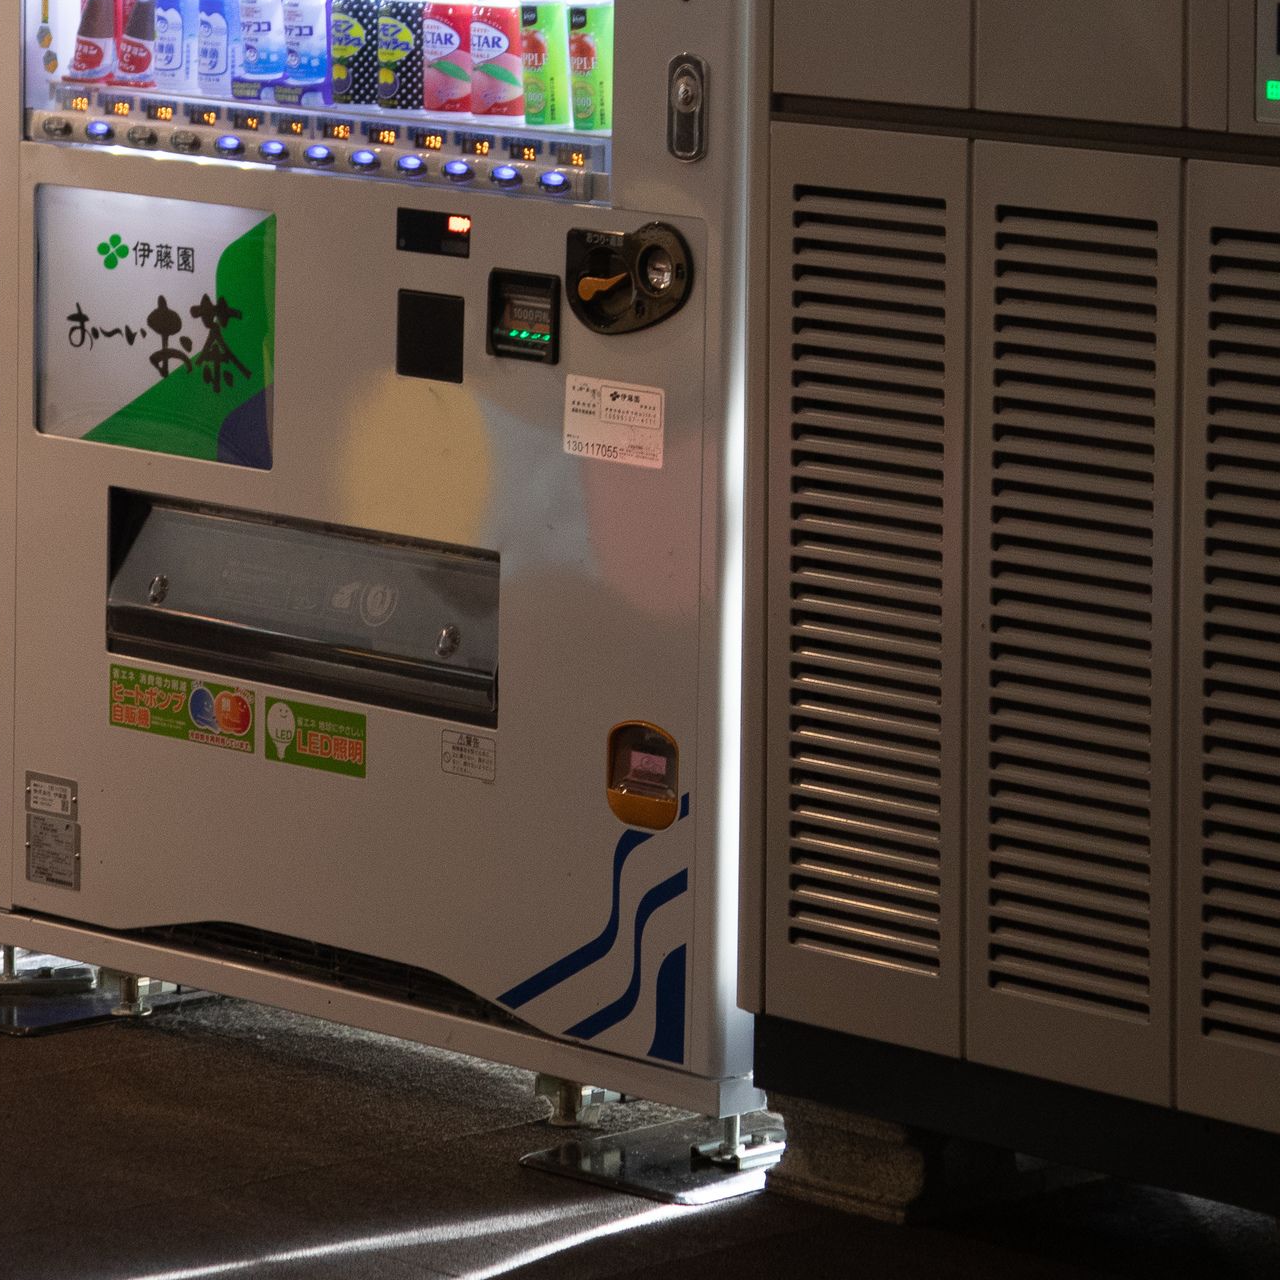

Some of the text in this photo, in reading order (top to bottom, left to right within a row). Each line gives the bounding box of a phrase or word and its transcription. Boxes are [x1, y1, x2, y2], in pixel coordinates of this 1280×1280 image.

[132, 240, 195, 274] 伊藤園
[111, 680, 187, 714] ヒートポンプ
[111, 703, 152, 730] 自販機
[275, 727, 293, 742] LED
[296, 728, 365, 766] LED照明
